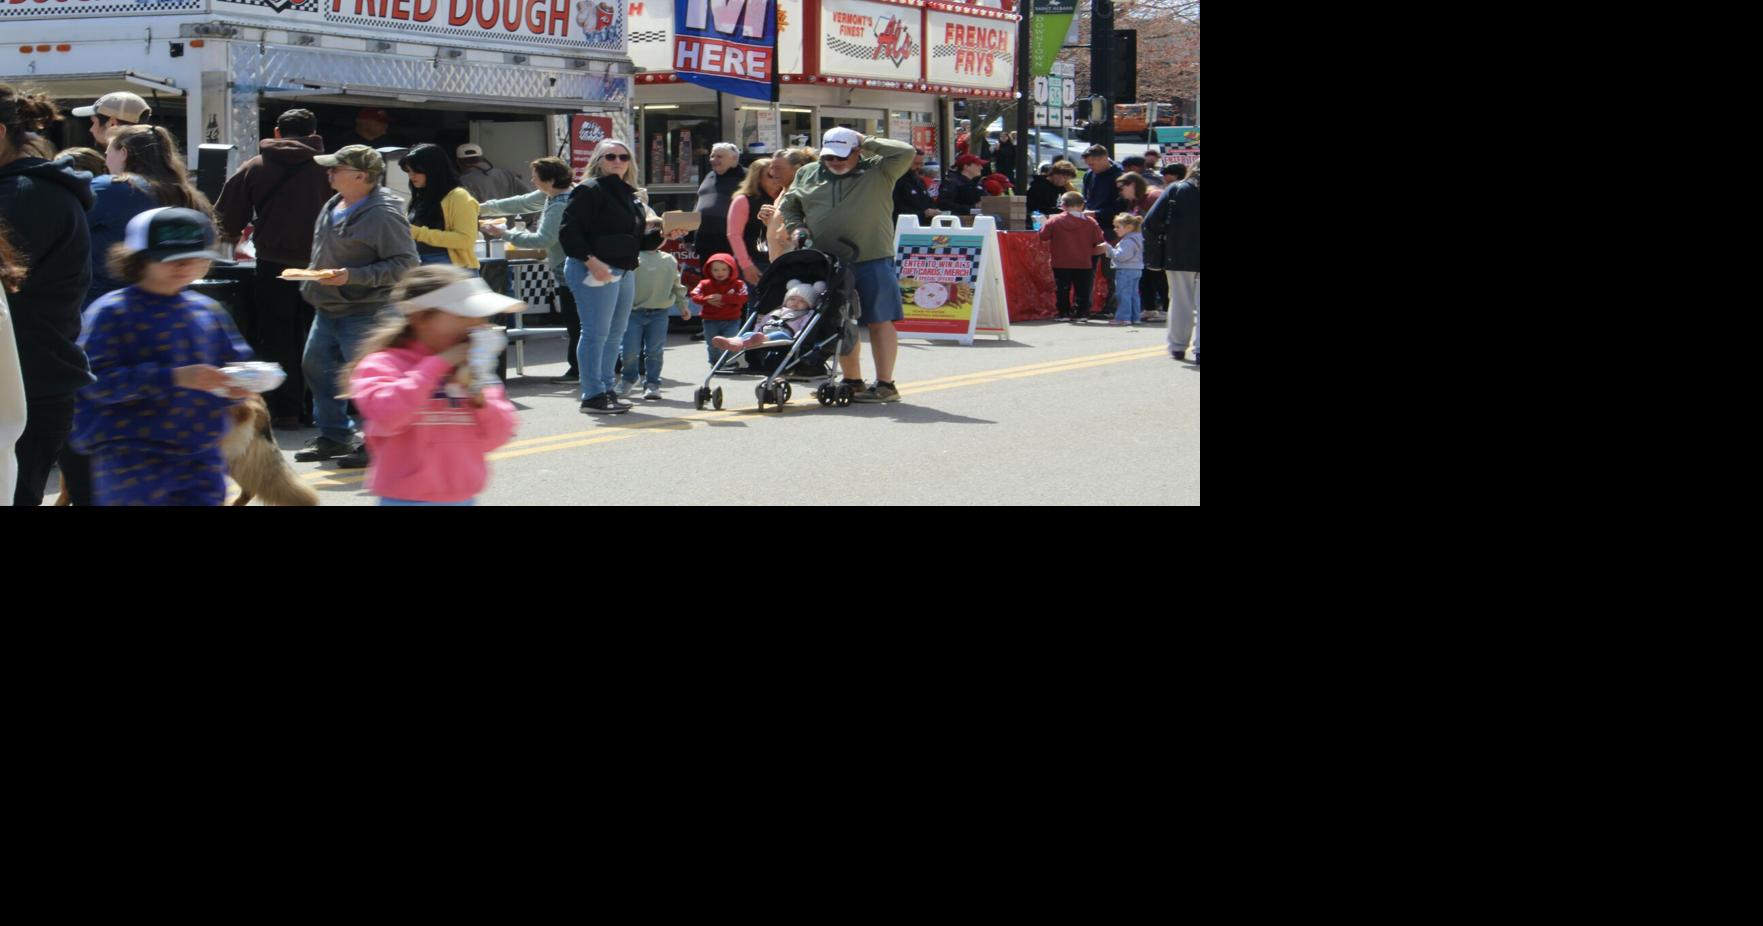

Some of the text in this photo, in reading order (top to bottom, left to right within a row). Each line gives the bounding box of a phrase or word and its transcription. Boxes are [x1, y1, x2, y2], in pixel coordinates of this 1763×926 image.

[448, 0, 570, 37] DOUGH
[832, 11, 873, 27] VERMONT'S
[840, 24, 865, 37] FINEST
[945, 22, 1008, 51] FRENCH
[676, 41, 767, 79] HERE
[955, 48, 994, 77] FRYS
[1038, 81, 1044, 98] 7
[1066, 84, 1071, 100] 7
